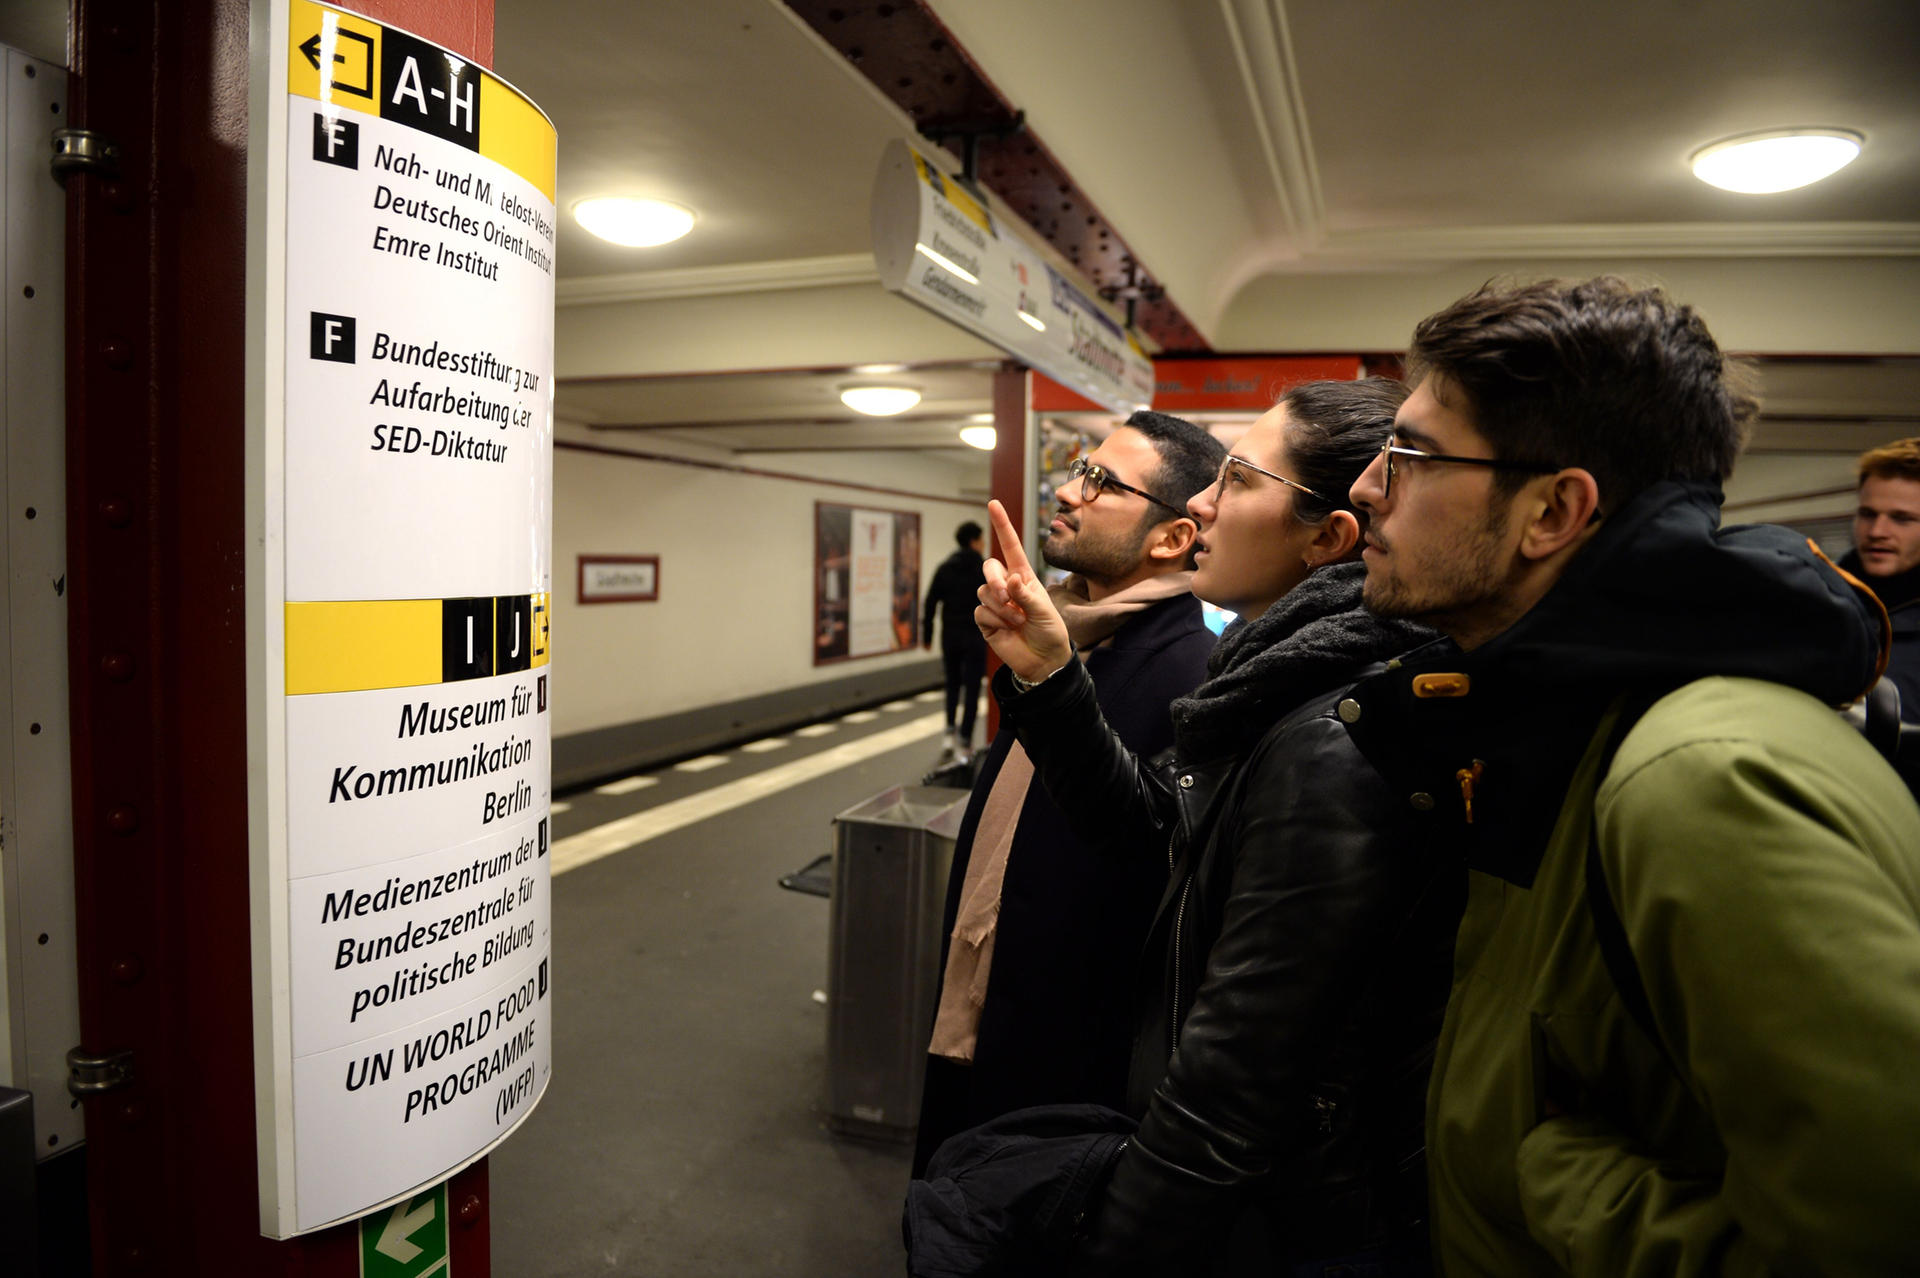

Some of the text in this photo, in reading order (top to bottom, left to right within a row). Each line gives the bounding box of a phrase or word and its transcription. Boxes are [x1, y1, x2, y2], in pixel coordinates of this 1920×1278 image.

[391, 55, 473, 134] A-H
[327, 123, 346, 158] F
[374, 144, 554, 244] Nah- und Mitelost-Verein
[373, 184, 552, 276] Deutsches Orient Institut
[373, 225, 499, 282] Emre Institut
[324, 319, 343, 355] F
[370, 378, 510, 430] Aufarbeitung
[523, 370, 539, 393] zur
[370, 423, 508, 464] SED-Diktatur
[466, 611, 520, 664] I J
[398, 685, 532, 739] Museum für
[329, 734, 532, 804] Kommunikation
[482, 779, 532, 825] Berlin
[321, 836, 535, 924] Medienzentrum der
[334, 876, 535, 970] Bundeszentrale für
[350, 919, 535, 1023] politische Bildung
[345, 978, 535, 1092] UN WORLD FOOD
[404, 1019, 535, 1124] PROGRAMME
[495, 1061, 535, 1125] (WFP)
